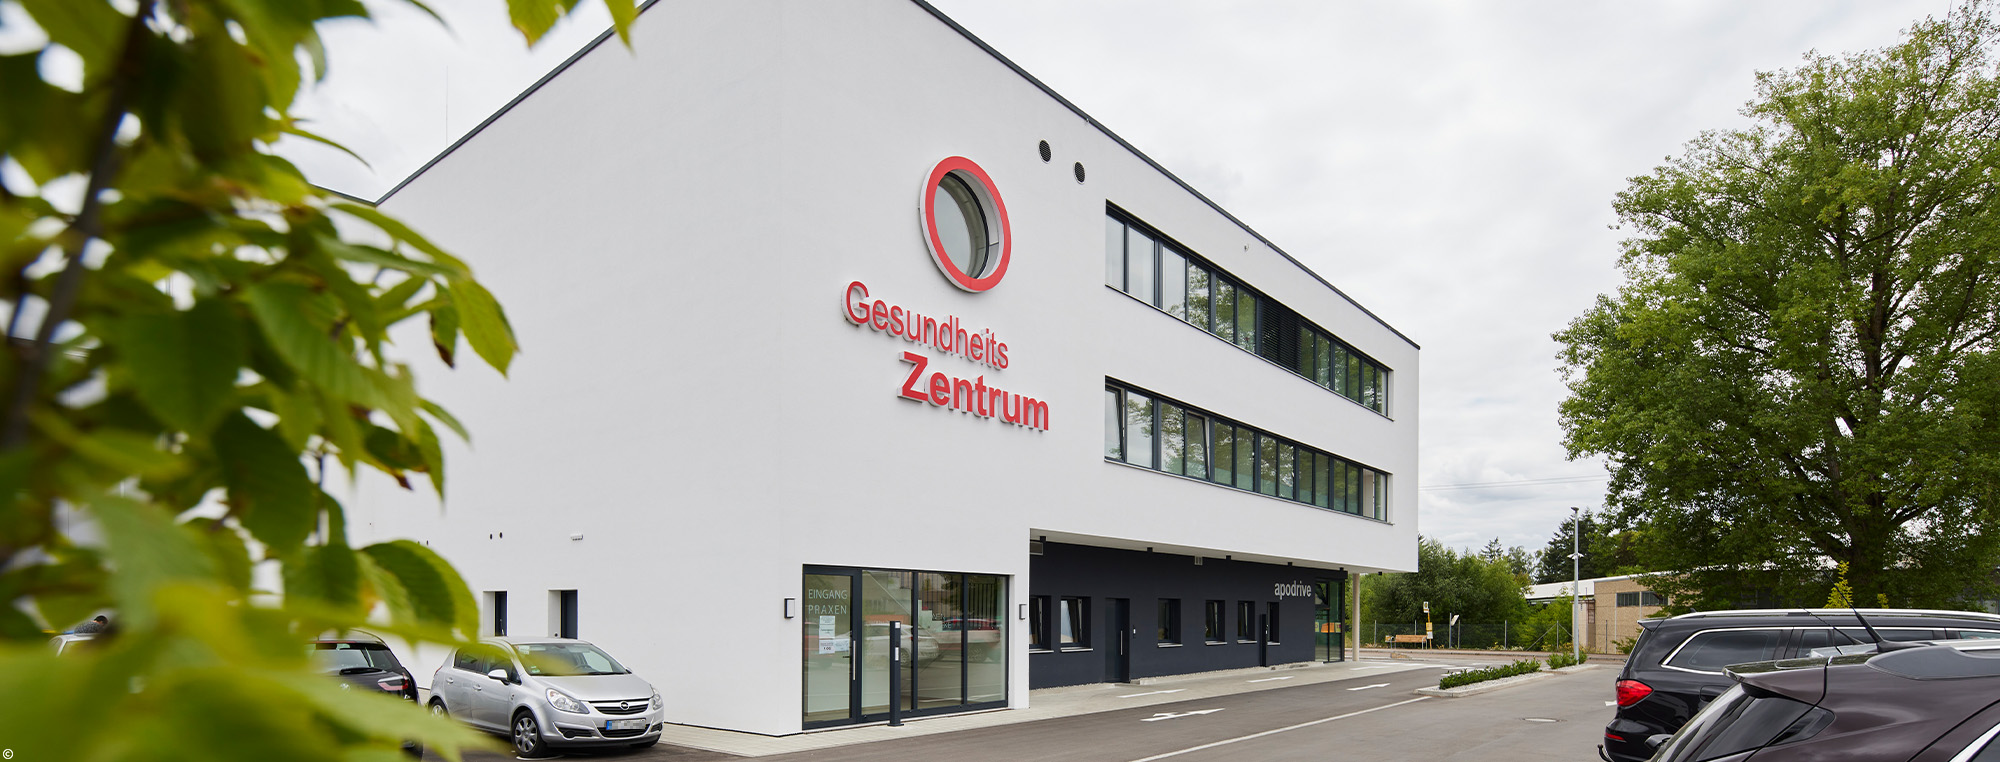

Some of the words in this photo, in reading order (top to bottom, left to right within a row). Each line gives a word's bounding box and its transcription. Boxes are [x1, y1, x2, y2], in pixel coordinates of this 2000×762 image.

[842, 280, 1009, 370] Gesundheits
[898, 351, 1049, 431] Zentrum
[808, 588, 848, 600] EINGANG
[1274, 580, 1312, 600] apodrive
[808, 604, 847, 615] PRAXEN
